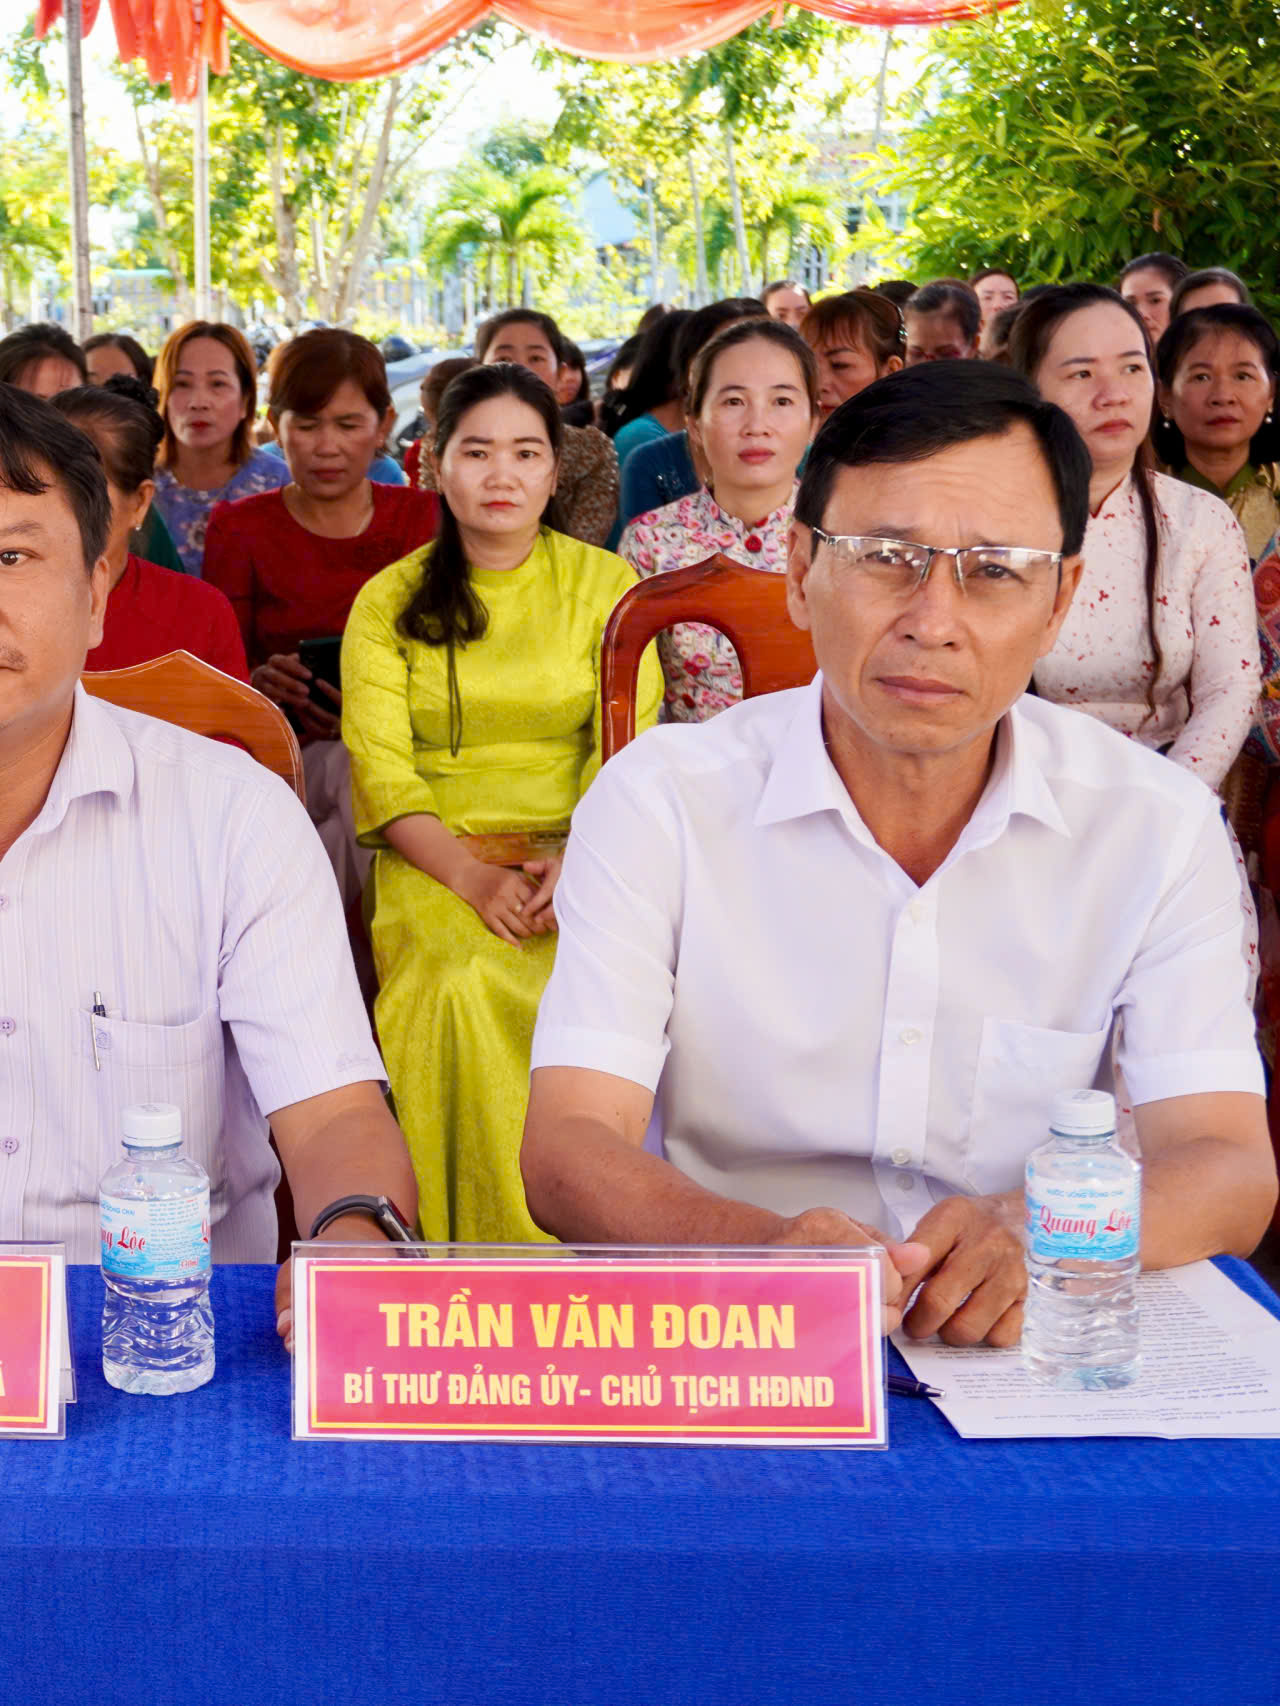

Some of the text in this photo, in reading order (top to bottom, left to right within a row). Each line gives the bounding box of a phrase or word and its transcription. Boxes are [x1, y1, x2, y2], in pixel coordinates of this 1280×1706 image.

[1040, 1205, 1096, 1239] Quang
[378, 1287, 796, 1349] TRẦN VĂN ĐOAN
[343, 1366, 373, 1404] BÍ
[382, 1370, 442, 1405] THƯ
[447, 1363, 531, 1406] ĐẢNG
[601, 1364, 662, 1407] CHỦ
[670, 1375, 740, 1414] TỊCH
[748, 1375, 834, 1407] HĐND
